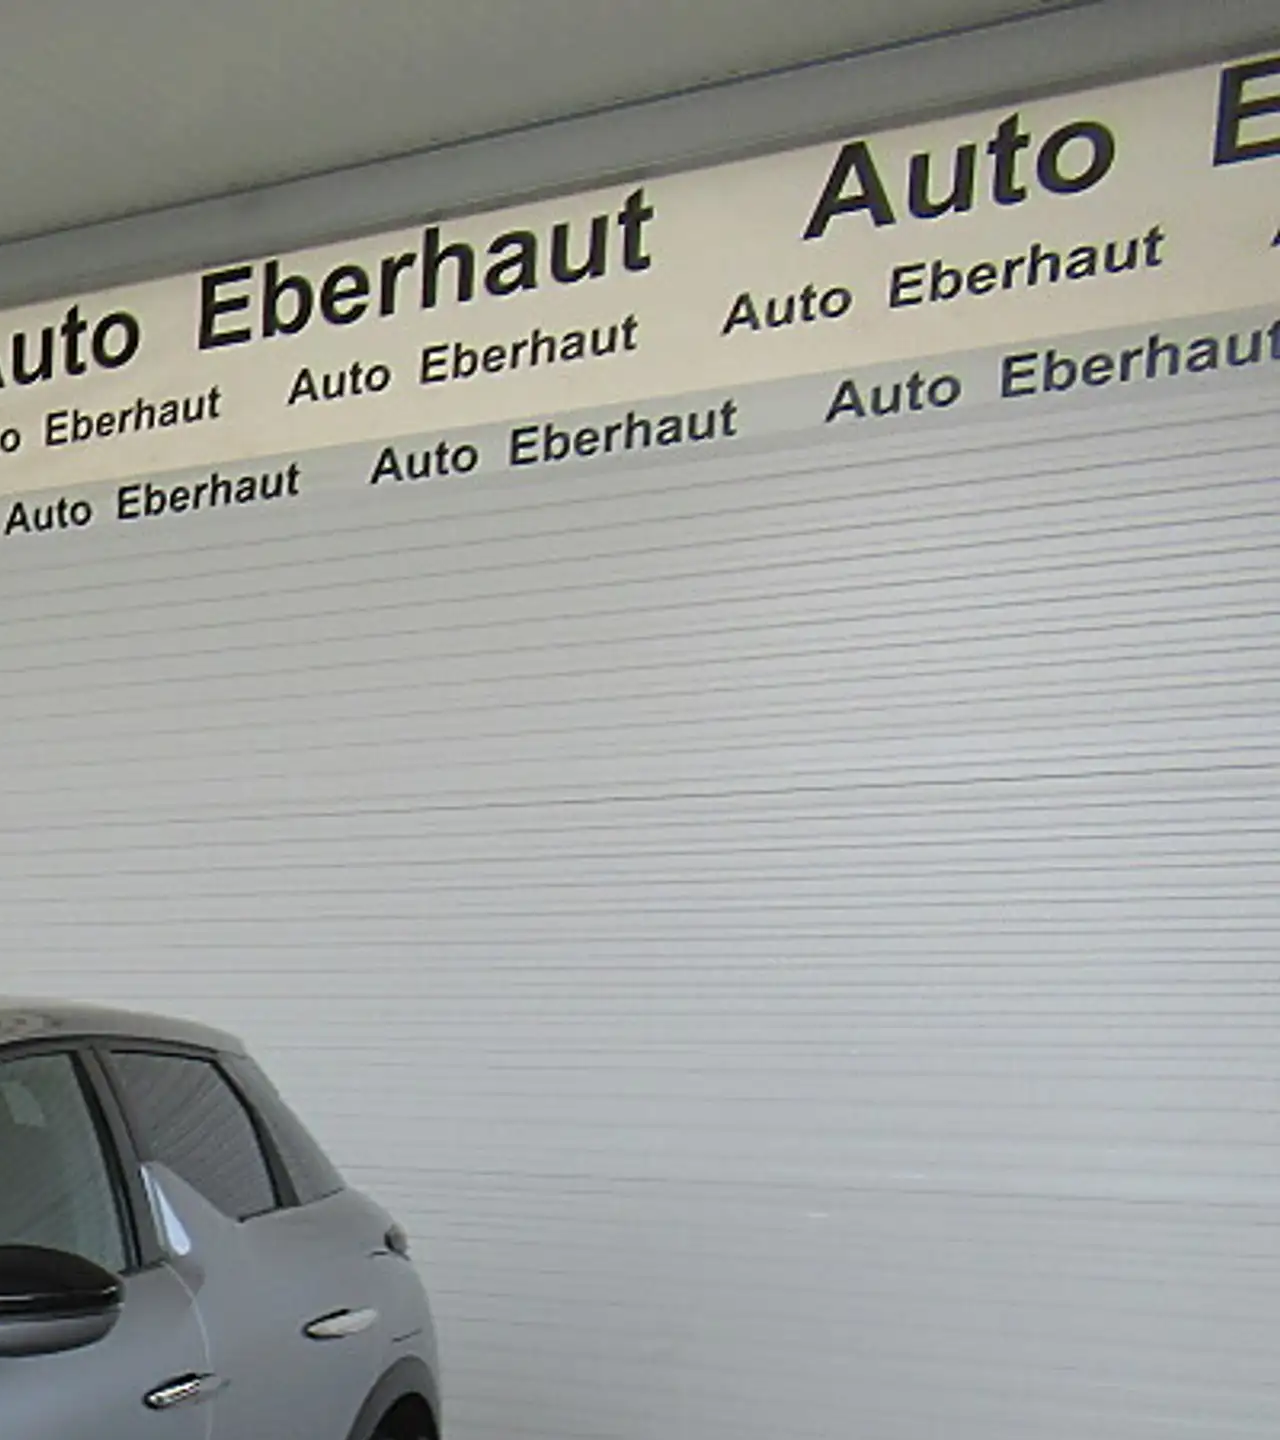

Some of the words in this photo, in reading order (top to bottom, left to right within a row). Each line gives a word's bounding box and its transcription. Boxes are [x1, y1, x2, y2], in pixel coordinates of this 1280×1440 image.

[803, 112, 1115, 241] Auto
[198, 187, 655, 350] Eberhaut
[722, 284, 852, 335] Auto
[889, 225, 1164, 308] Eberhaut
[287, 361, 391, 405] Auto
[420, 315, 638, 384] Eberhaut
[825, 371, 961, 423] Auto
[45, 387, 221, 446] Eberhaut
[370, 441, 478, 485] Auto
[510, 400, 737, 466] Eberhaut
[4, 497, 92, 536] Auto
[117, 463, 300, 520] Eberhaut
